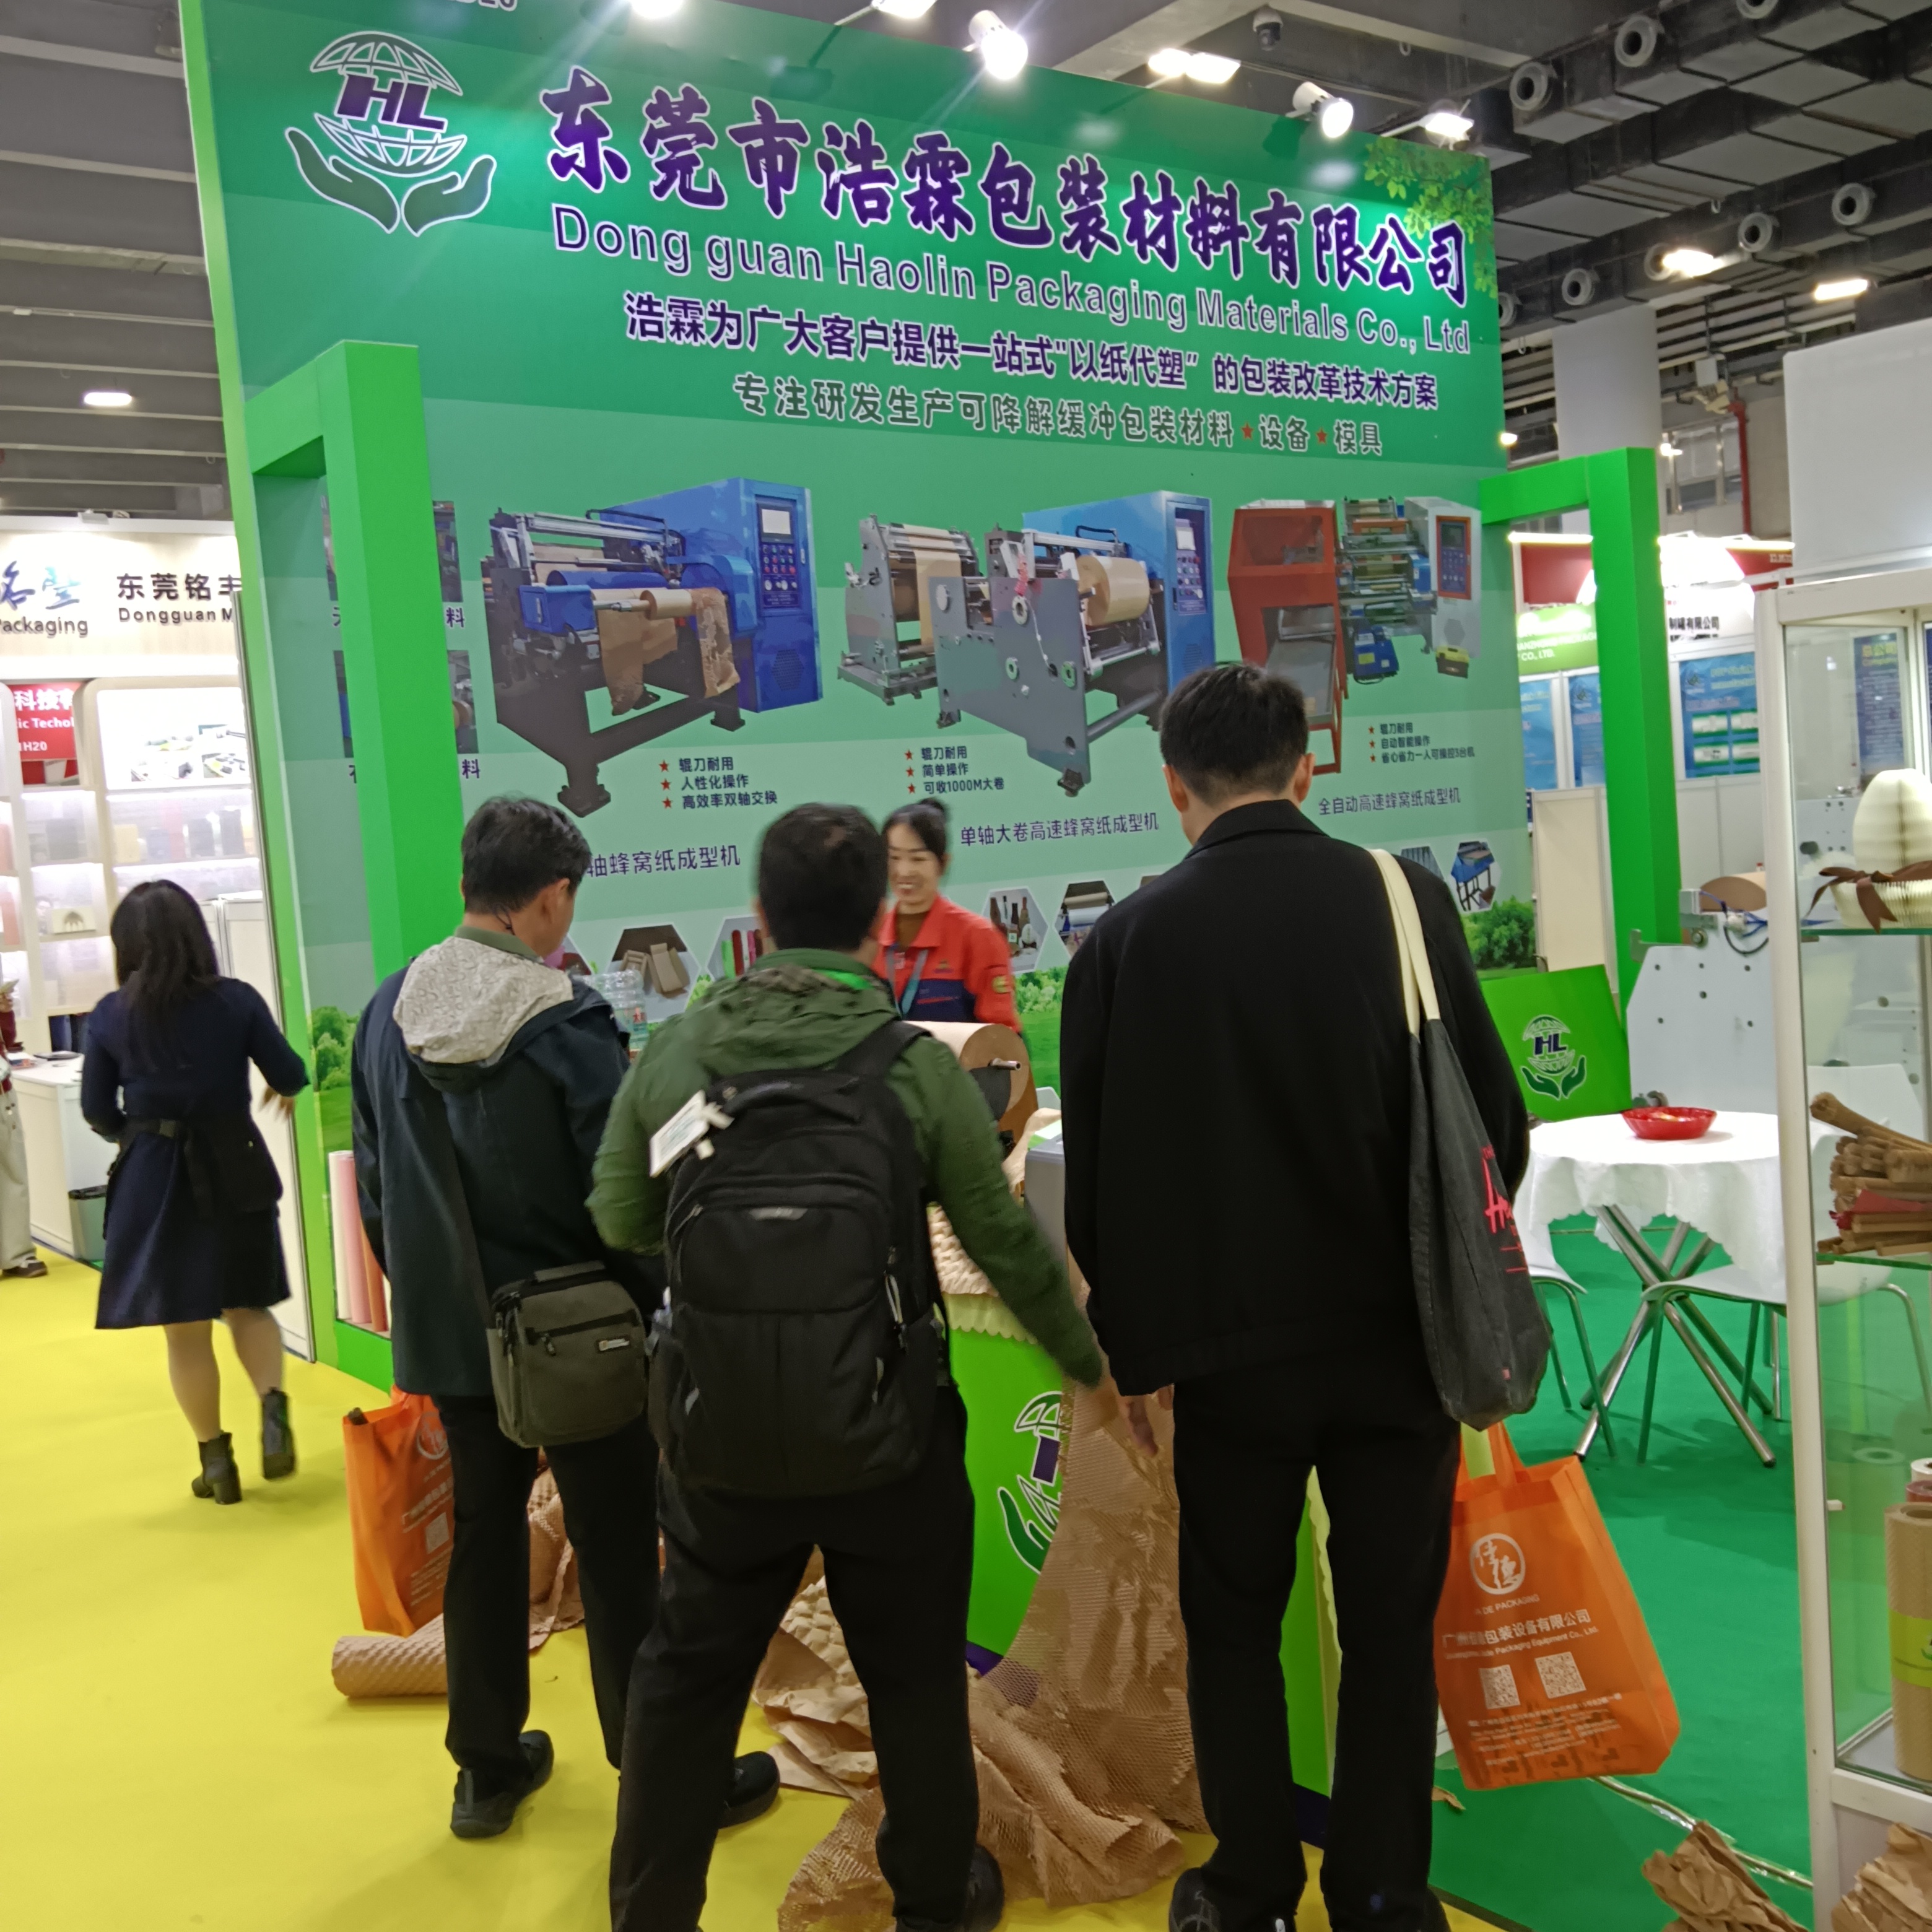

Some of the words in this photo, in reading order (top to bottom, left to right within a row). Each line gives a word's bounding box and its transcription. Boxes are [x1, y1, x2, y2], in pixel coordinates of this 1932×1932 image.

[334, 72, 448, 133] HL
[540, 66, 1468, 308] 东莞市浩霖包装材料有限公司
[552, 203, 691, 276] Dong
[705, 233, 824, 282] guan
[835, 241, 976, 299] Haolin
[986, 261, 1186, 333] Packaging
[1196, 289, 1348, 343] Materials
[1356, 307, 1417, 356] Co.,
[1424, 315, 1471, 355] Ltd
[1213, 354, 1438, 410] 的包装改革技术方案
[734, 373, 1235, 448] 专注研发生产可降解缓冲包装材料
[1258, 414, 1310, 453] 设备
[1334, 420, 1382, 456] 模具
[118, 607, 216, 624] Dongguan
[0, 617, 89, 637] ackaging
[921, 746, 968, 760] 辊刀耐用
[679, 757, 734, 773] 辊刀耐用
[922, 764, 969, 778] 简单操作
[681, 773, 749, 791] 人性化操作
[924, 778, 1005, 795] 可收1000M大卷
[682, 790, 778, 809] 高效率双轴交换
[1318, 787, 1461, 816] 全自动高速蜂窝纸成型机
[960, 812, 1160, 847] 单轴大卷高速蜂窝纸成型机
[1534, 1033, 1568, 1056] HL
[1495, 1593, 1540, 1611] PACKAGING
